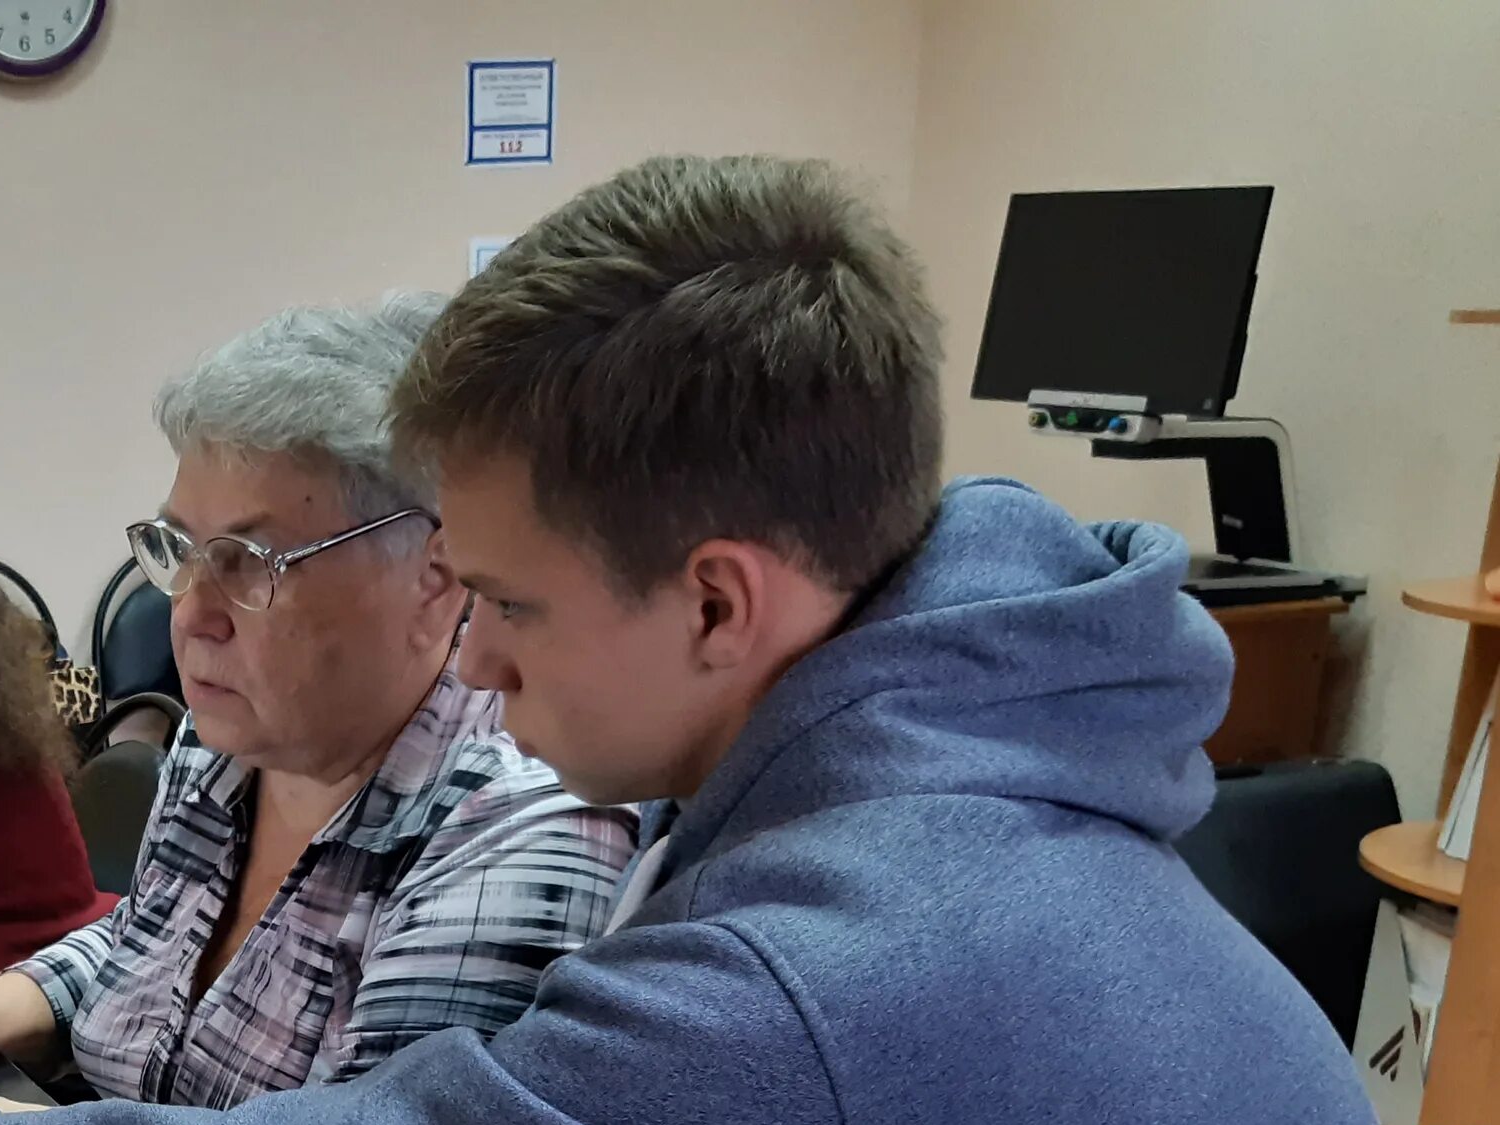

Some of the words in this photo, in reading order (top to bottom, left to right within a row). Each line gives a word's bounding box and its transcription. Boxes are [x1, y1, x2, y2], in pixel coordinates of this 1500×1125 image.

[63, 8, 73, 24] 4
[18, 36, 31, 52] 6
[44, 28, 56, 45] 5
[498, 140, 524, 154] 112
